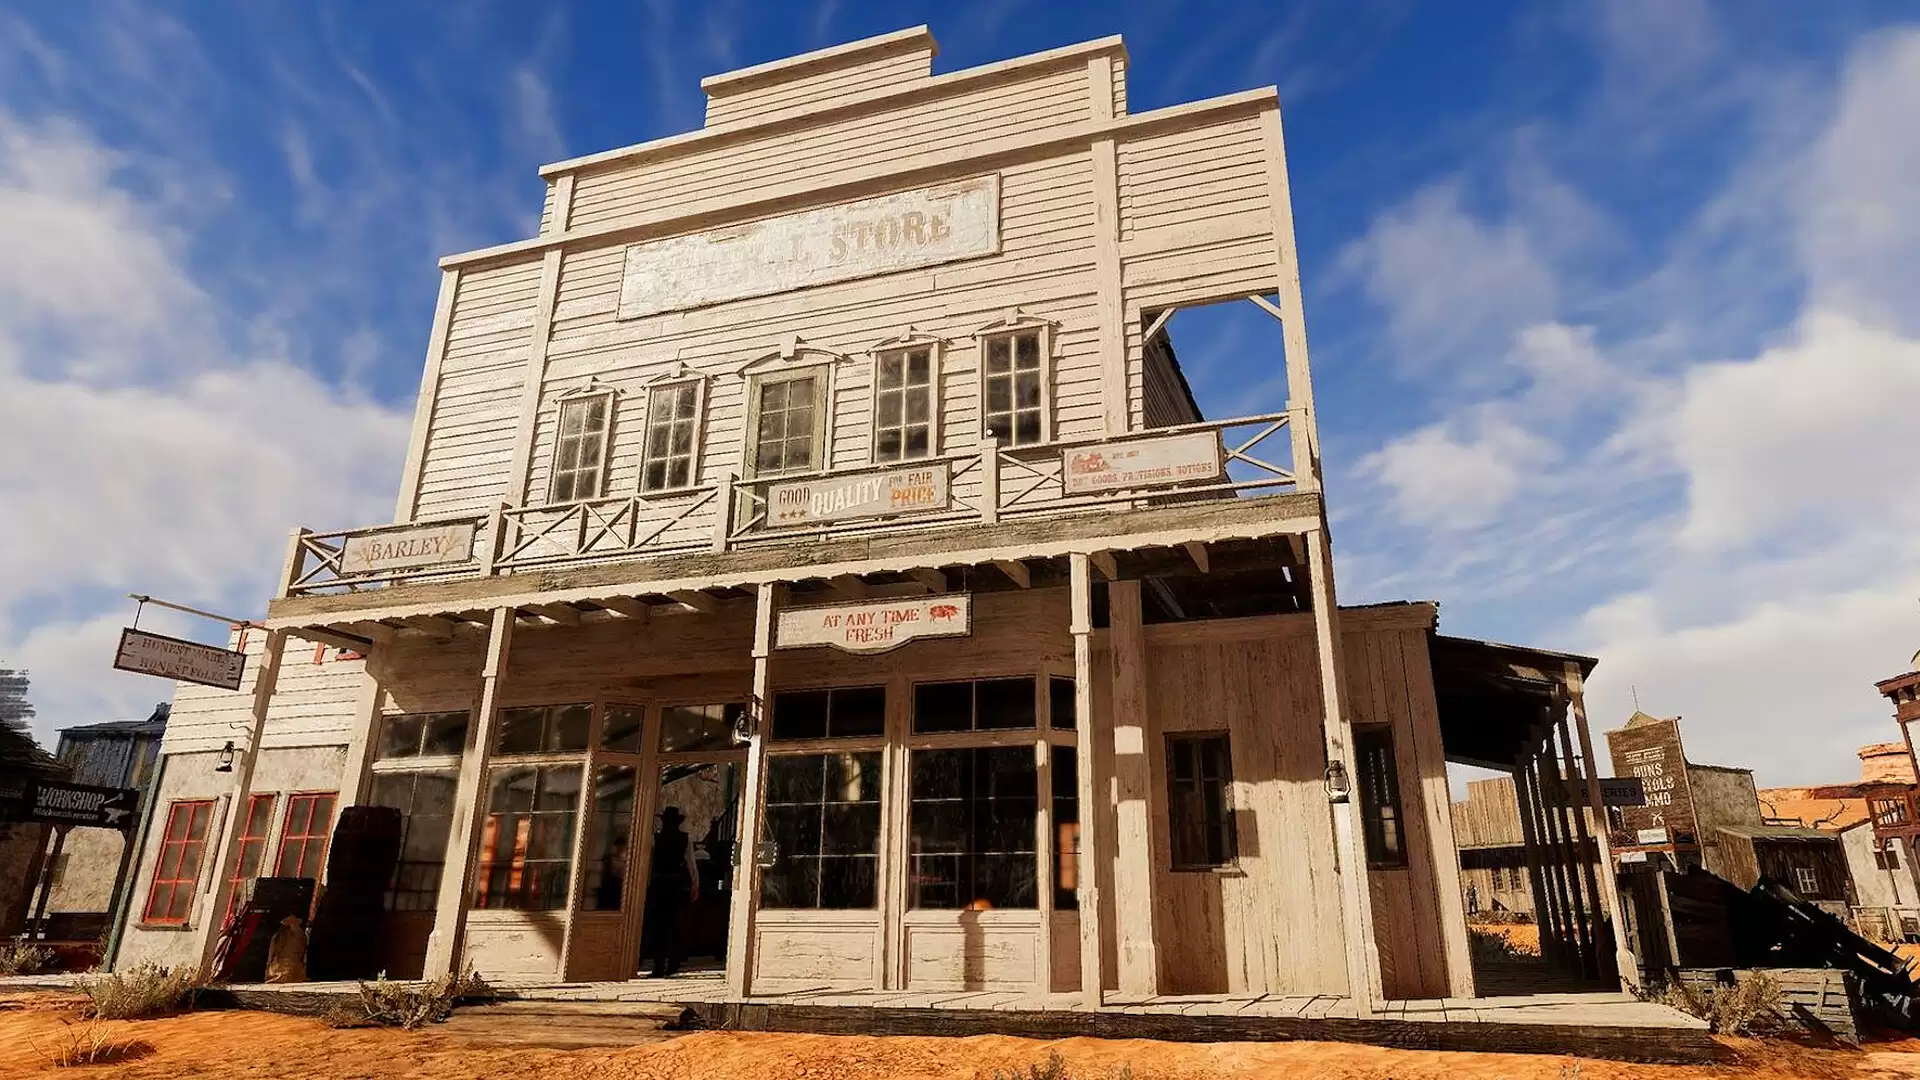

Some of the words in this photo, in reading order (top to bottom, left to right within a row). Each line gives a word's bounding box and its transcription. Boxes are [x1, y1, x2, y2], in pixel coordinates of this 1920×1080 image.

[829, 208, 952, 263] STORE
[779, 486, 811, 506] GOOD
[811, 476, 884, 518] QUALITY
[888, 475, 903, 487] FOR
[908, 471, 933, 485] FAIR
[890, 485, 937, 508] PRICE
[370, 536, 443, 561] BARLEY
[823, 615, 842, 629] AT
[845, 612, 876, 628] ANY
[881, 608, 920, 625] TIME
[846, 626, 894, 644] FRESH
[142, 638, 190, 657] HONEST
[139, 658, 189, 675] HONEST
[1633, 763, 1663, 778] GUNS
[36, 785, 105, 811] WORKSHOP
